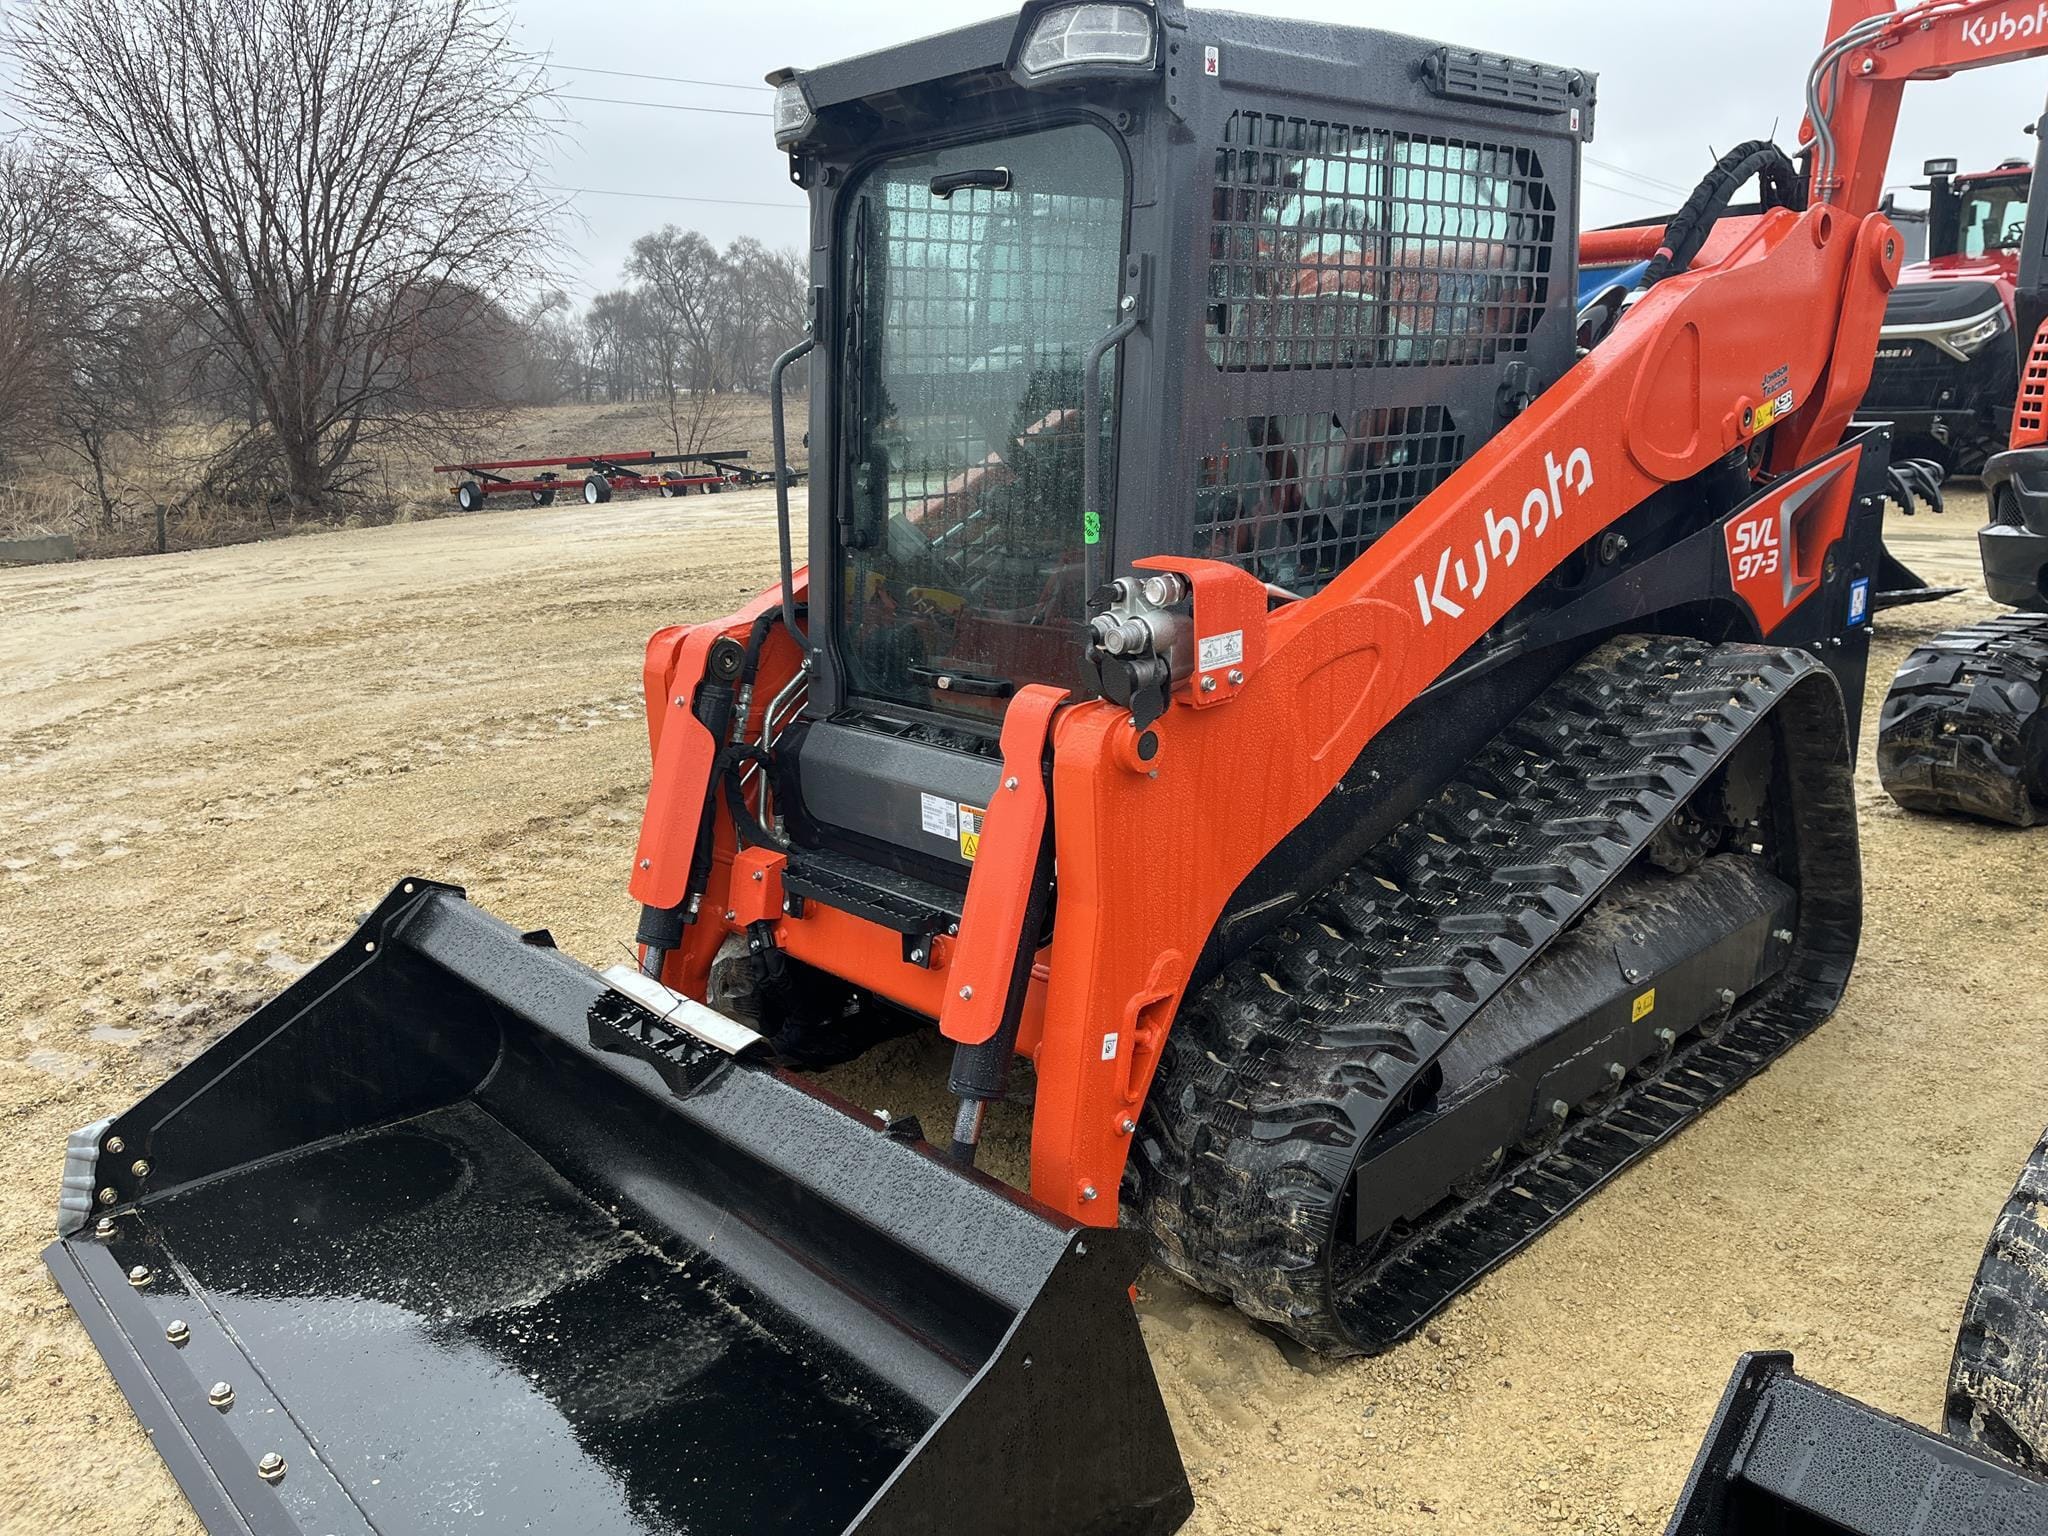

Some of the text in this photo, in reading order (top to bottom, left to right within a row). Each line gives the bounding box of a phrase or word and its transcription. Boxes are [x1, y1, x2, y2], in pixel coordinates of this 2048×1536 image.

[1961, 3, 2048, 47] Kubot
[1762, 364, 1788, 388] JOHNSON
[1763, 376, 1788, 398] TRACTOR
[1414, 447, 1594, 627] Kubota
[1731, 517, 1779, 554] SVL
[1736, 549, 1779, 580] 97-3
